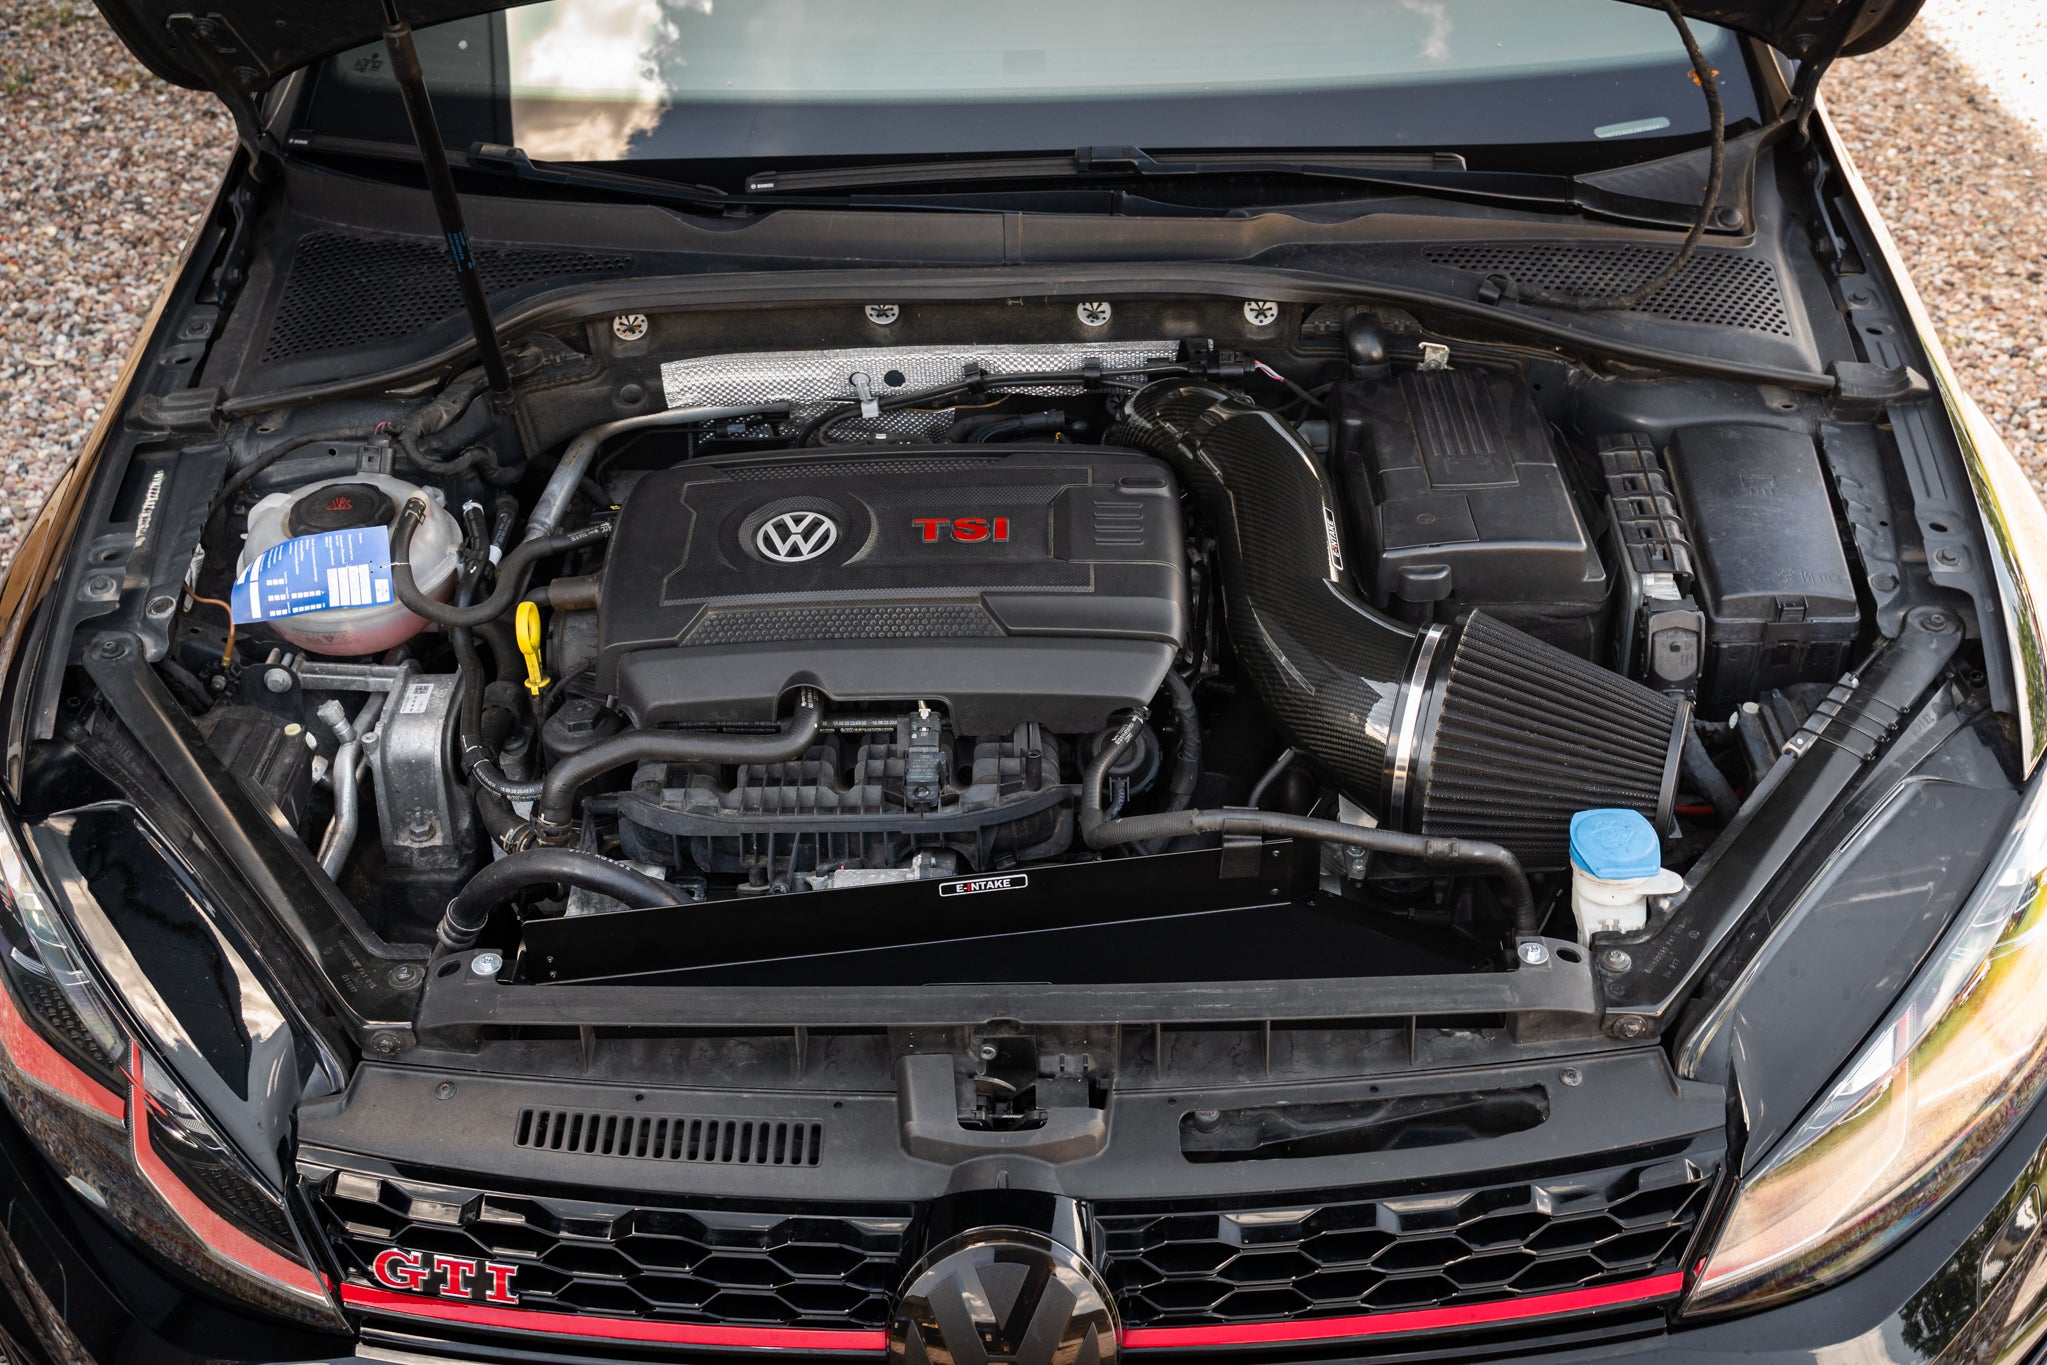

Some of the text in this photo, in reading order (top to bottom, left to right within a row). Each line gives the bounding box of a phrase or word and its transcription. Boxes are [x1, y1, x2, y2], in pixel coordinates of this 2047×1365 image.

[912, 516, 1010, 543] TSI
[956, 878, 1012, 893] E-INTAKE
[373, 1248, 520, 1305] GTI
